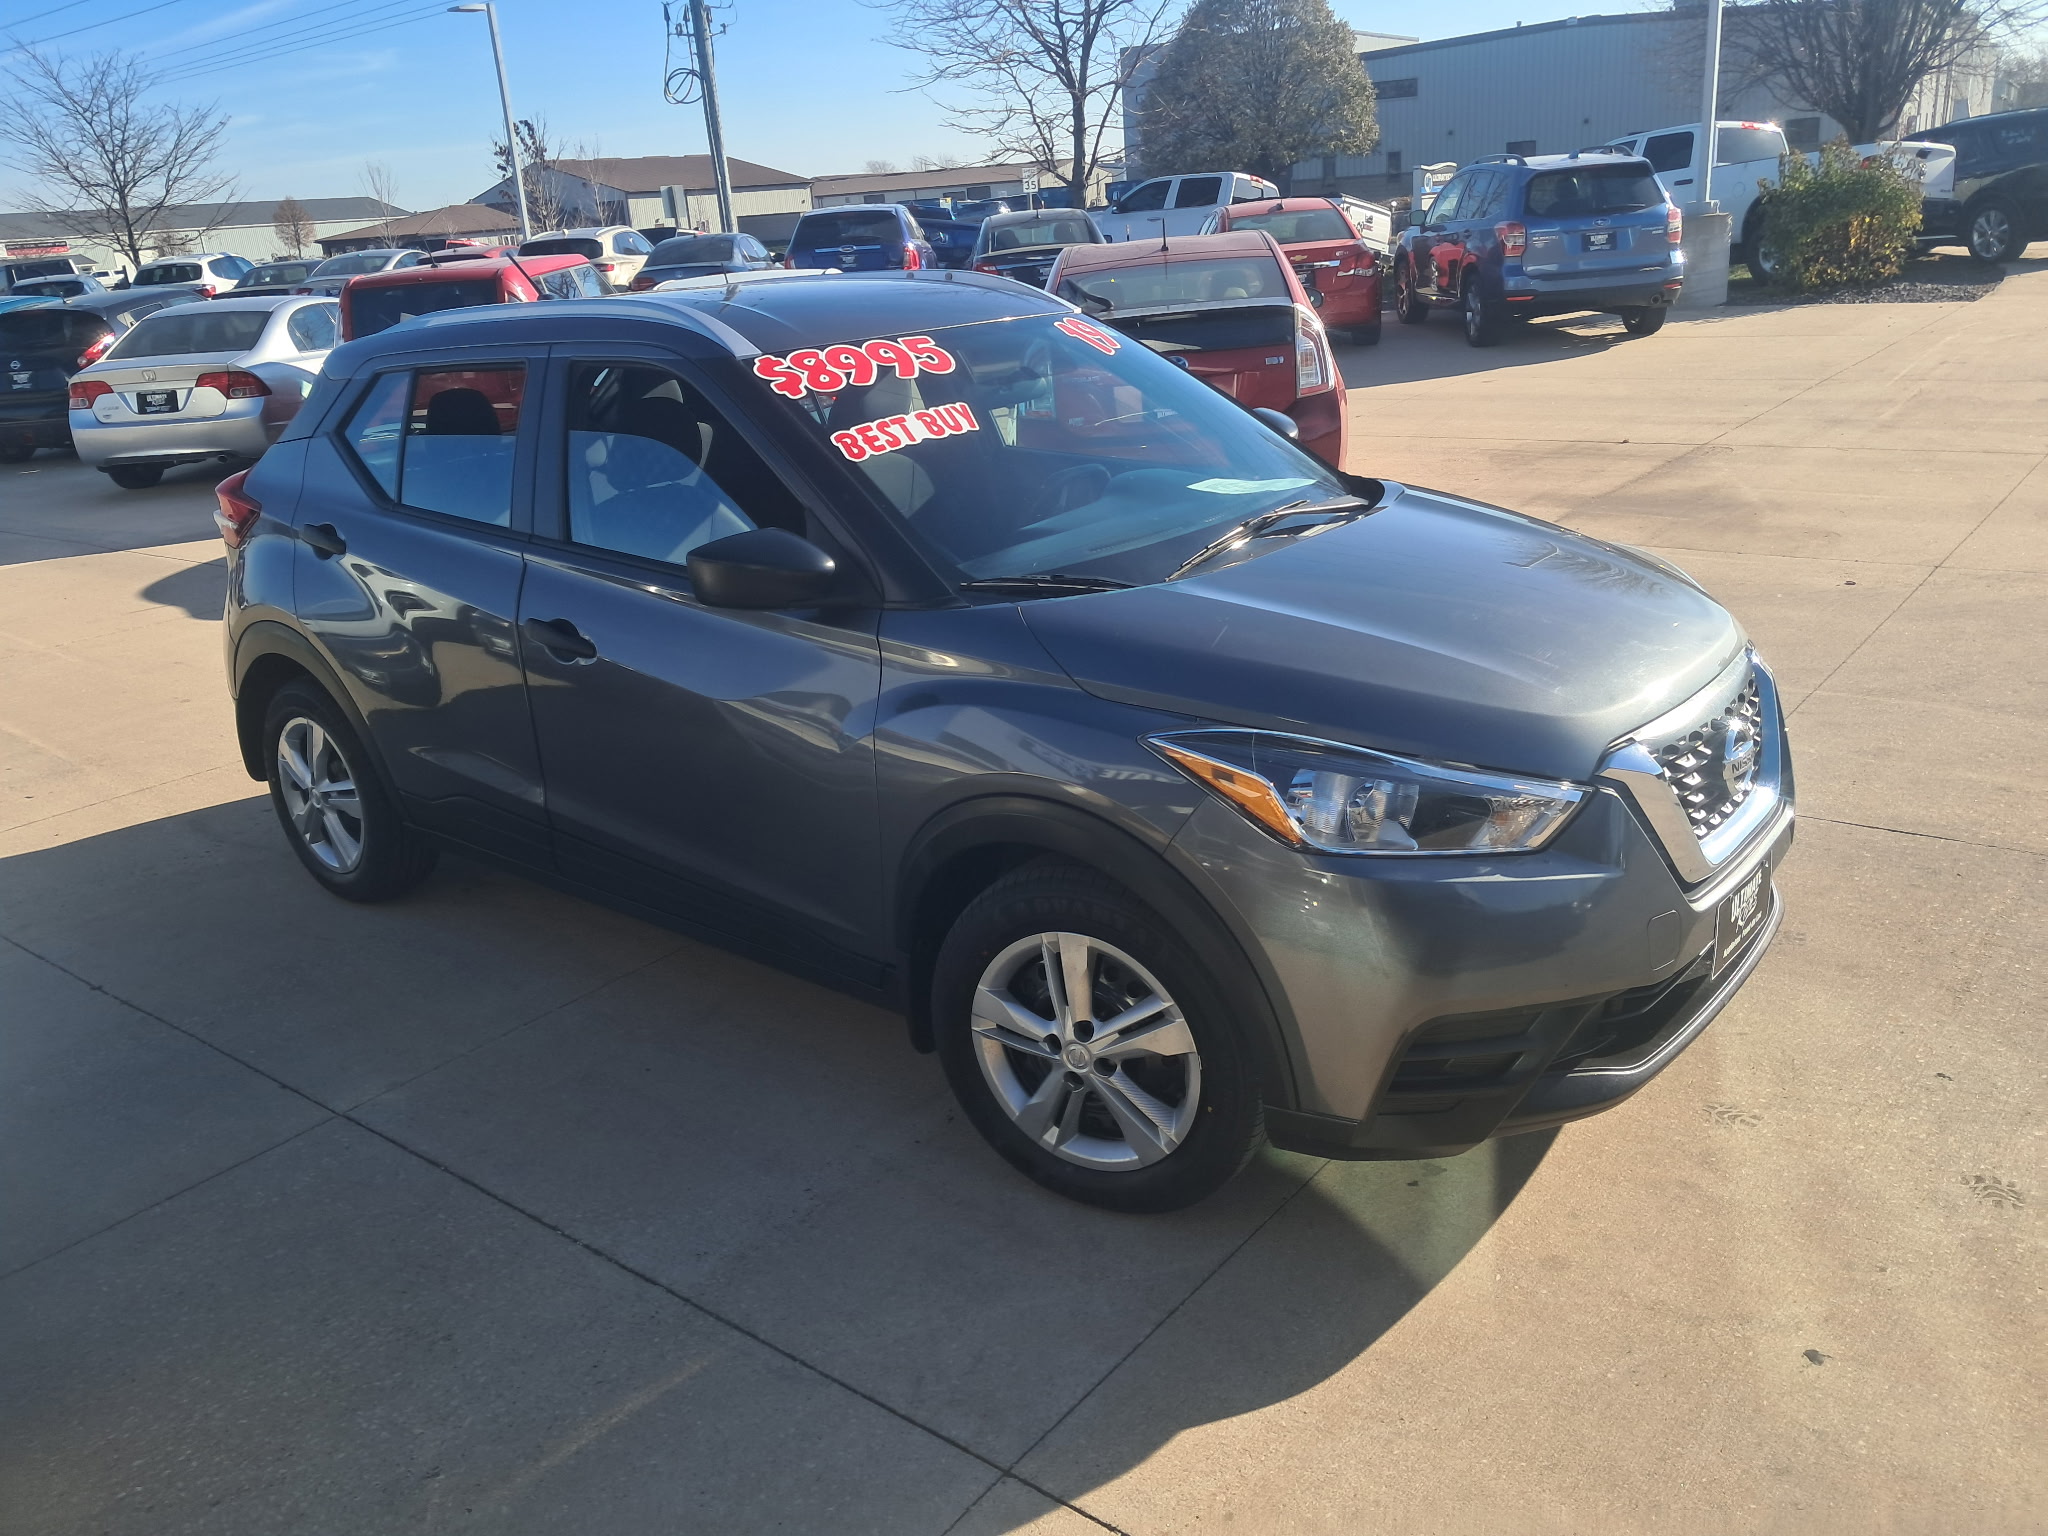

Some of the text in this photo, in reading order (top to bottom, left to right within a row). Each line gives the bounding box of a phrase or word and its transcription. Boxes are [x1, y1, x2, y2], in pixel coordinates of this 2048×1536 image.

[1024, 181, 1037, 190] 35
[1053, 317, 1122, 355] 19
[754, 336, 956, 399] $8995
[830, 402, 980, 462] BEST BUY
[1731, 753, 1753, 774] NISS
[1730, 868, 1762, 923] ULTIMATE
